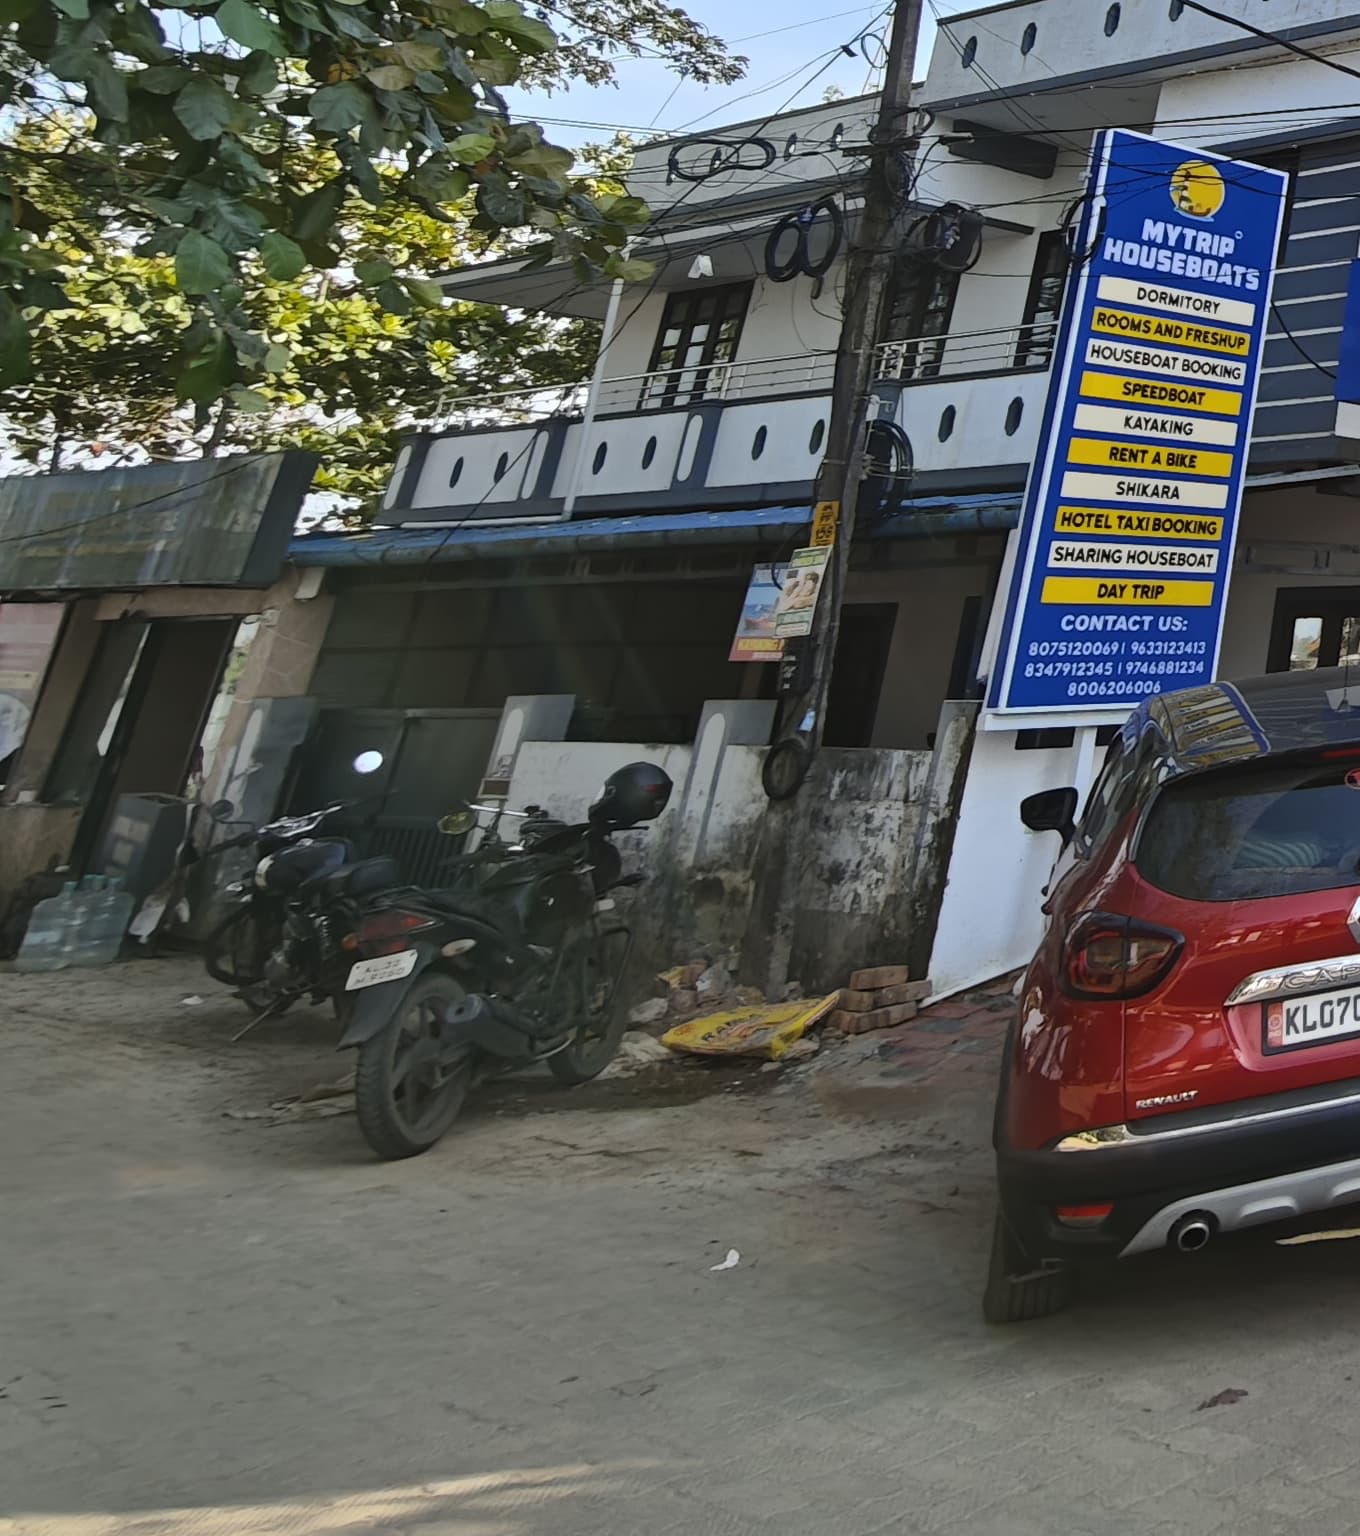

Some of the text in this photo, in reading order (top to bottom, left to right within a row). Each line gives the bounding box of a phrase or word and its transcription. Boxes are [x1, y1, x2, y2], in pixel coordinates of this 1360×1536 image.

[1141, 218, 1235, 258] MYTRIP
[1103, 237, 1260, 291] HOUSEBOATS
[1136, 287, 1221, 314] DORMITORY
[1097, 312, 1246, 350] ROOMS AND FRESHUP
[1090, 344, 1241, 380] HOUSEBOAT BOOKING
[1122, 381, 1206, 405] SPEEDBOAT
[1124, 415, 1194, 436] KAYAKING
[1109, 447, 1198, 469] RENT A BIKE
[1115, 481, 1180, 500] SHIKARA
[1060, 512, 1217, 535] HOTEL TAXI BOOKING
[1053, 546, 1214, 568] SHARING HOUSEBOAT
[1097, 583, 1165, 600] DAY TRIP
[1060, 615, 1188, 631] CONTACT US:
[1028, 642, 1121, 657] 8075120069
[1130, 641, 1206, 655] 9633123413
[1024, 662, 1113, 678] 8347912345
[1125, 661, 1204, 675] 9746881234
[1067, 681, 1161, 696] 8006206006
[1135, 1090, 1198, 1109] RENAULT
